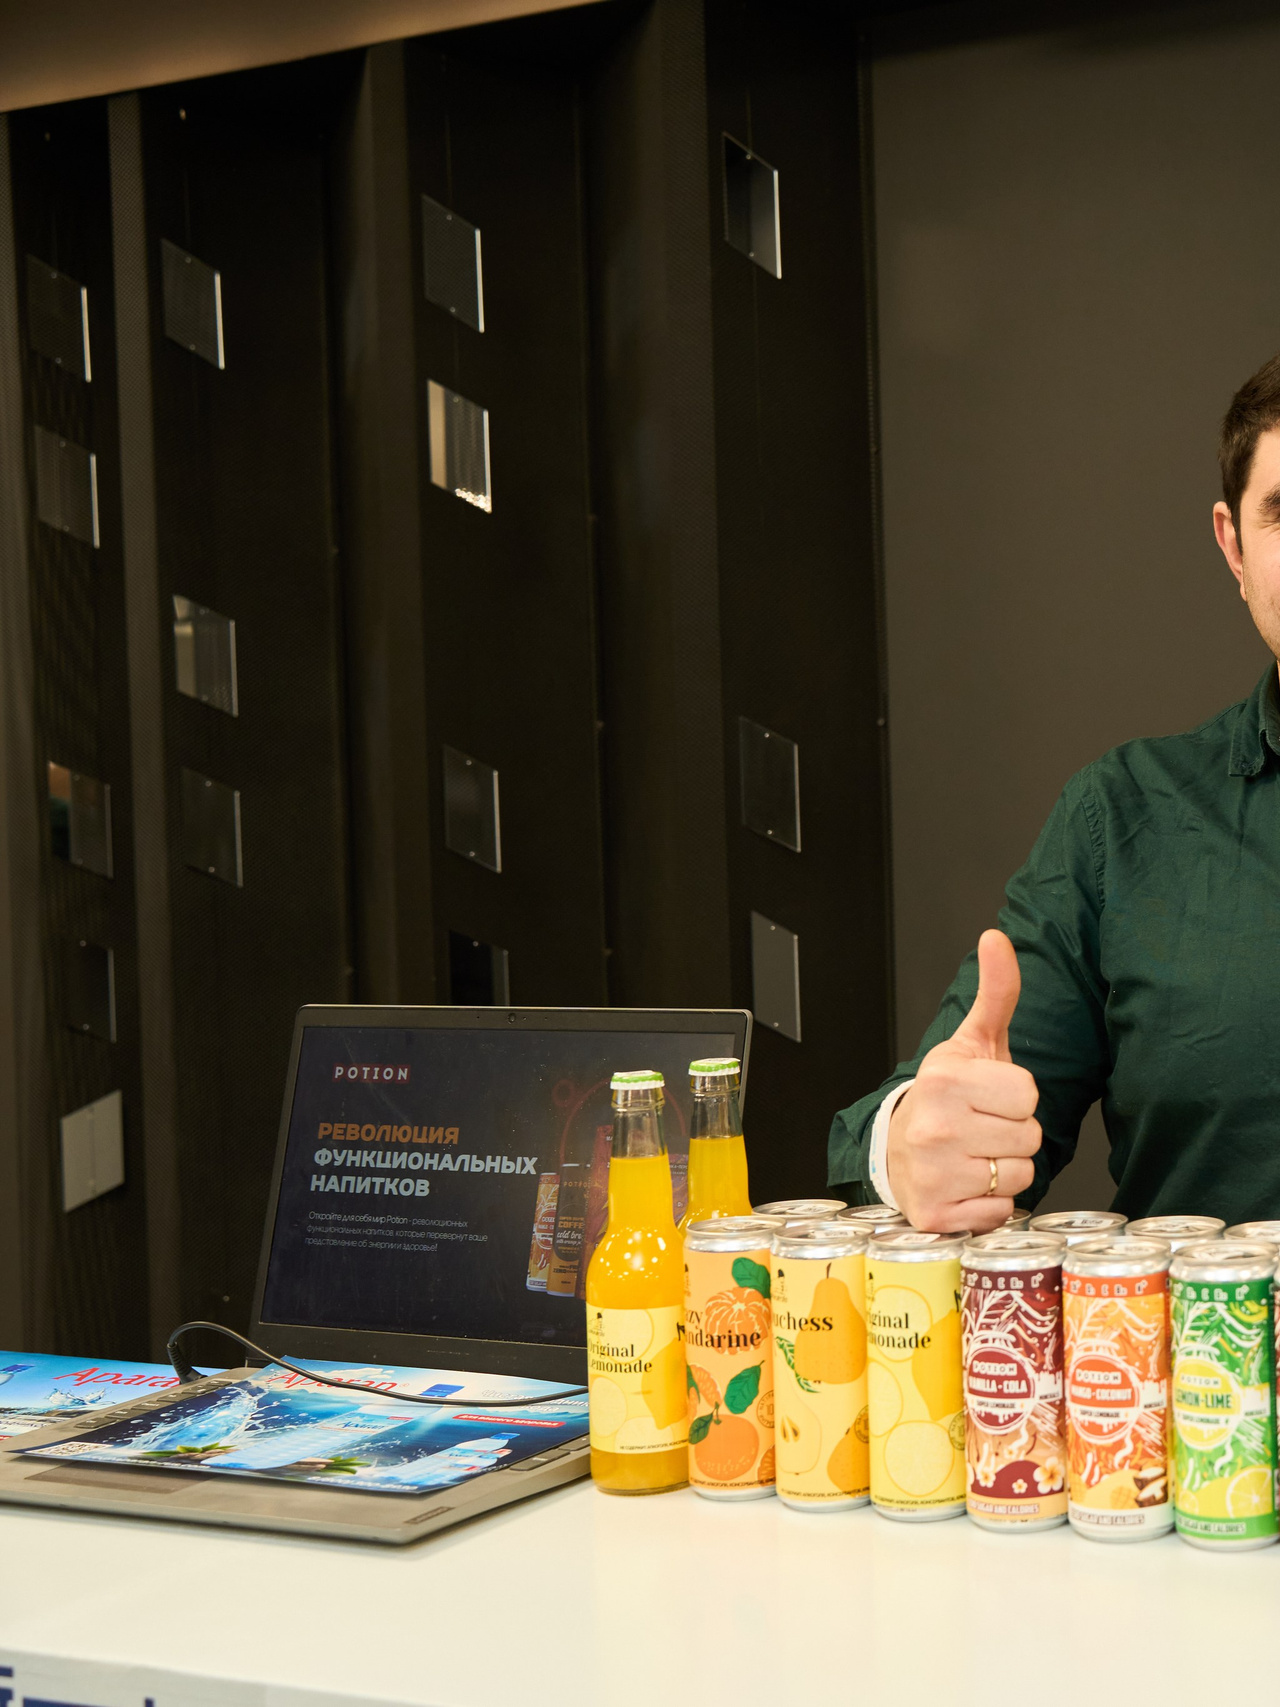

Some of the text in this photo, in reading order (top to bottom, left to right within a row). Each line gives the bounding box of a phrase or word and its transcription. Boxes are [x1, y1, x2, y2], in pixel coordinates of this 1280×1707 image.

[334, 1066, 409, 1080] POTION
[318, 1122, 460, 1145] РЕВОЛЮЦИЯ
[313, 1148, 538, 1175] ФУНКЦИОНАЛЬНЫХ
[310, 1175, 430, 1197] НАПИТКОВ
[773, 1311, 833, 1331] uchess
[685, 1329, 761, 1348] ndarine
[868, 1332, 931, 1348] monade
[590, 1359, 652, 1373] emonade
[973, 1362, 1016, 1374] POTION
[52, 1366, 181, 1389] Apara
[1077, 1370, 1121, 1384] POTION
[1003, 1379, 1028, 1393] COLA
[1096, 1388, 1132, 1401] COCONUT
[1205, 1393, 1232, 1408] LIME
